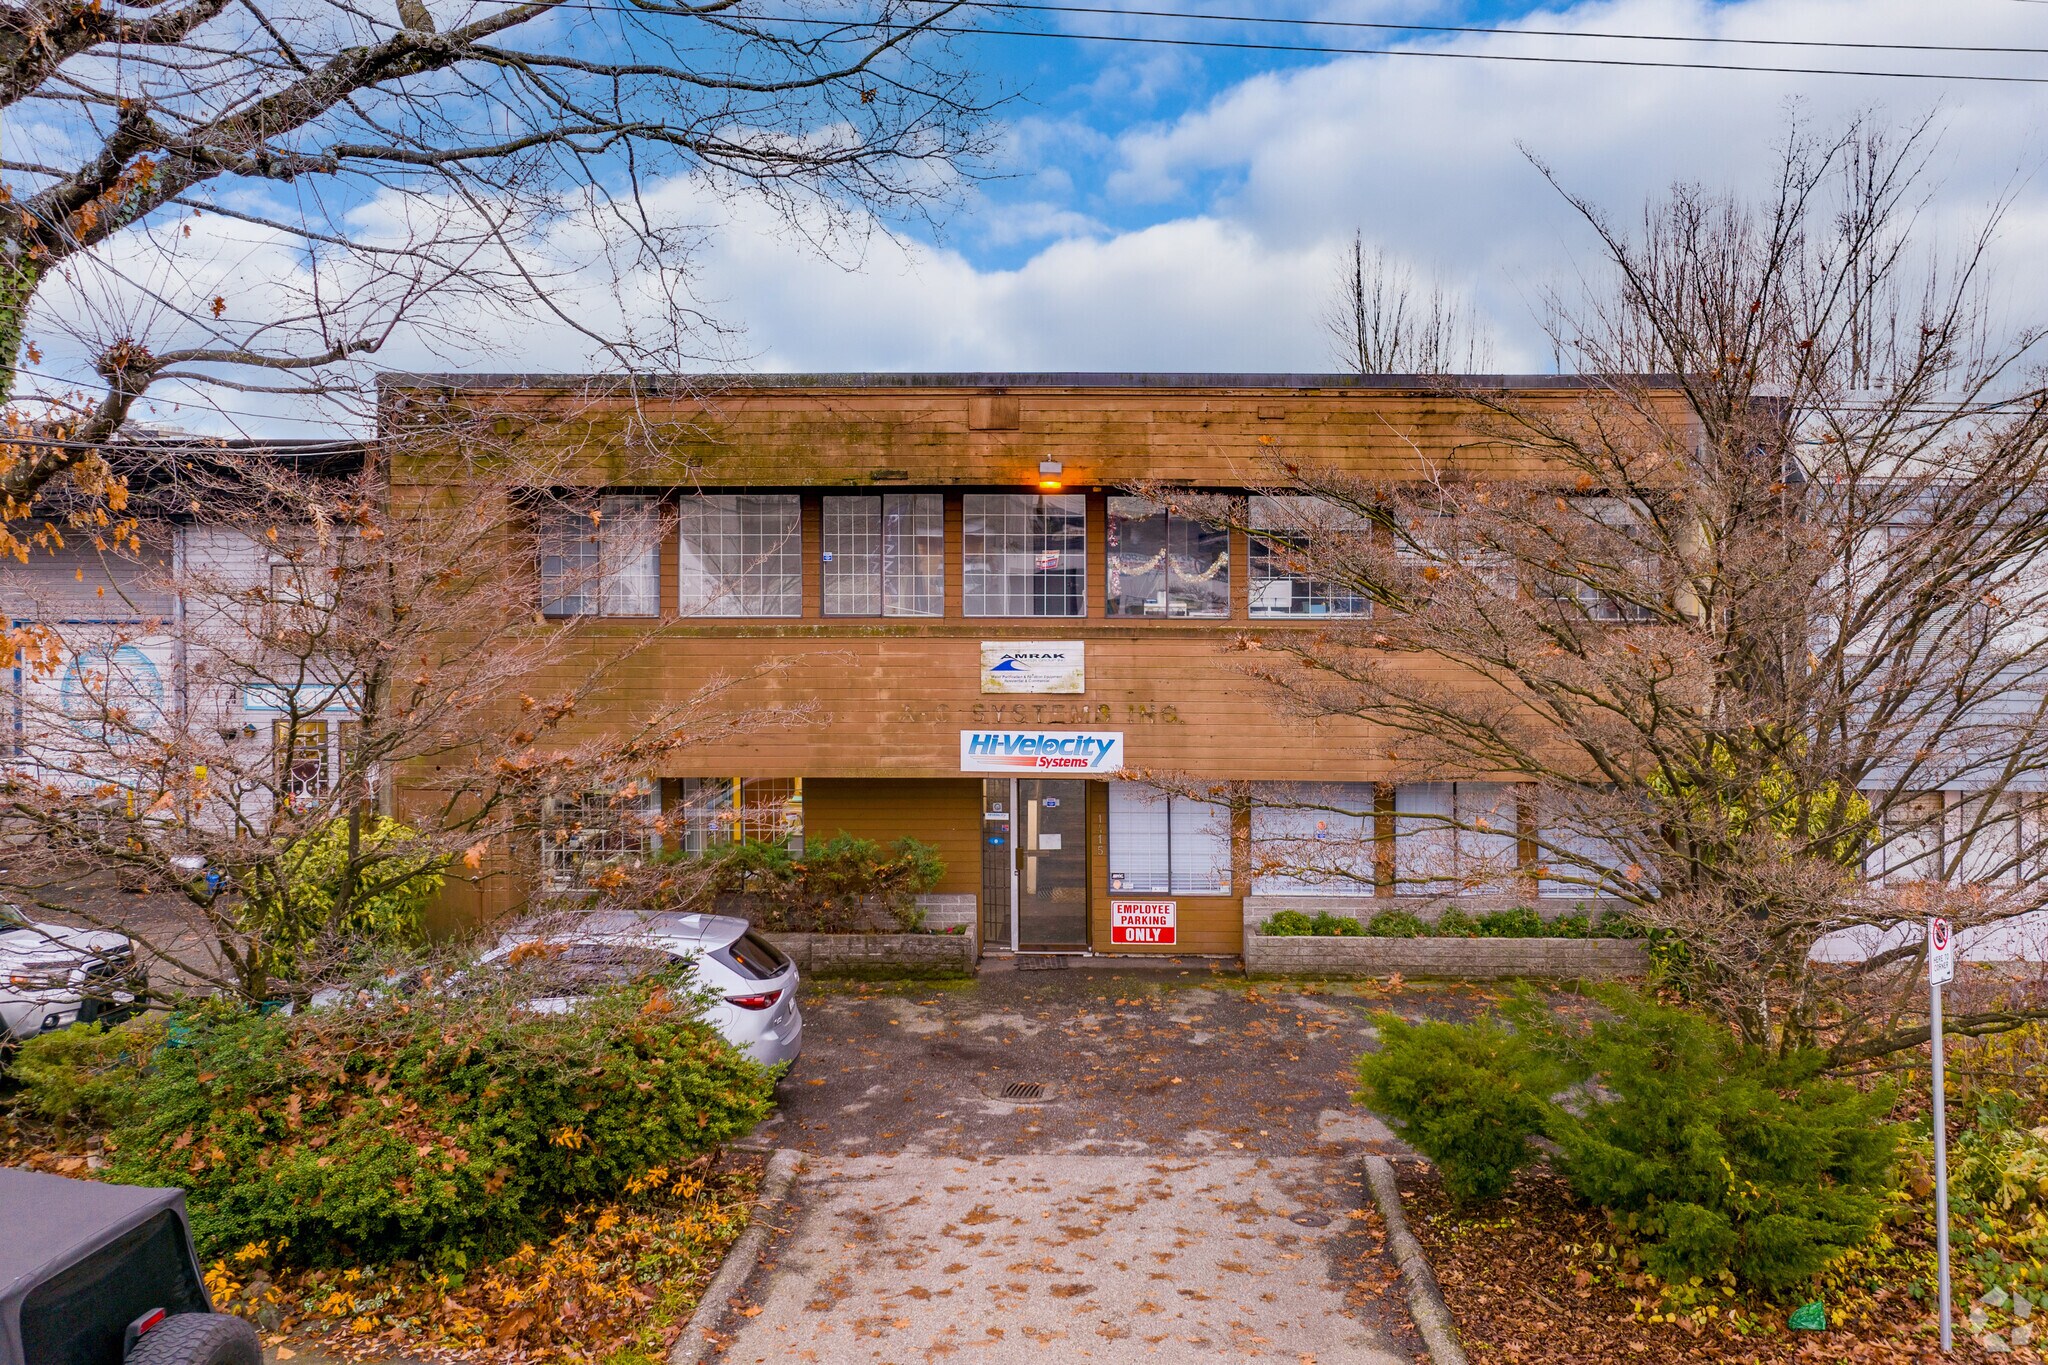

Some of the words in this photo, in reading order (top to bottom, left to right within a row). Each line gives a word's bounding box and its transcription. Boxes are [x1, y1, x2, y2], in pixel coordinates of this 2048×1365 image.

[968, 733, 1116, 767] Hi-Velocity
[1038, 756, 1088, 769] Systems
[1117, 904, 1170, 914] EMPLOYEE
[1121, 915, 1167, 925] PARKING
[1125, 927, 1161, 942] ONLY
